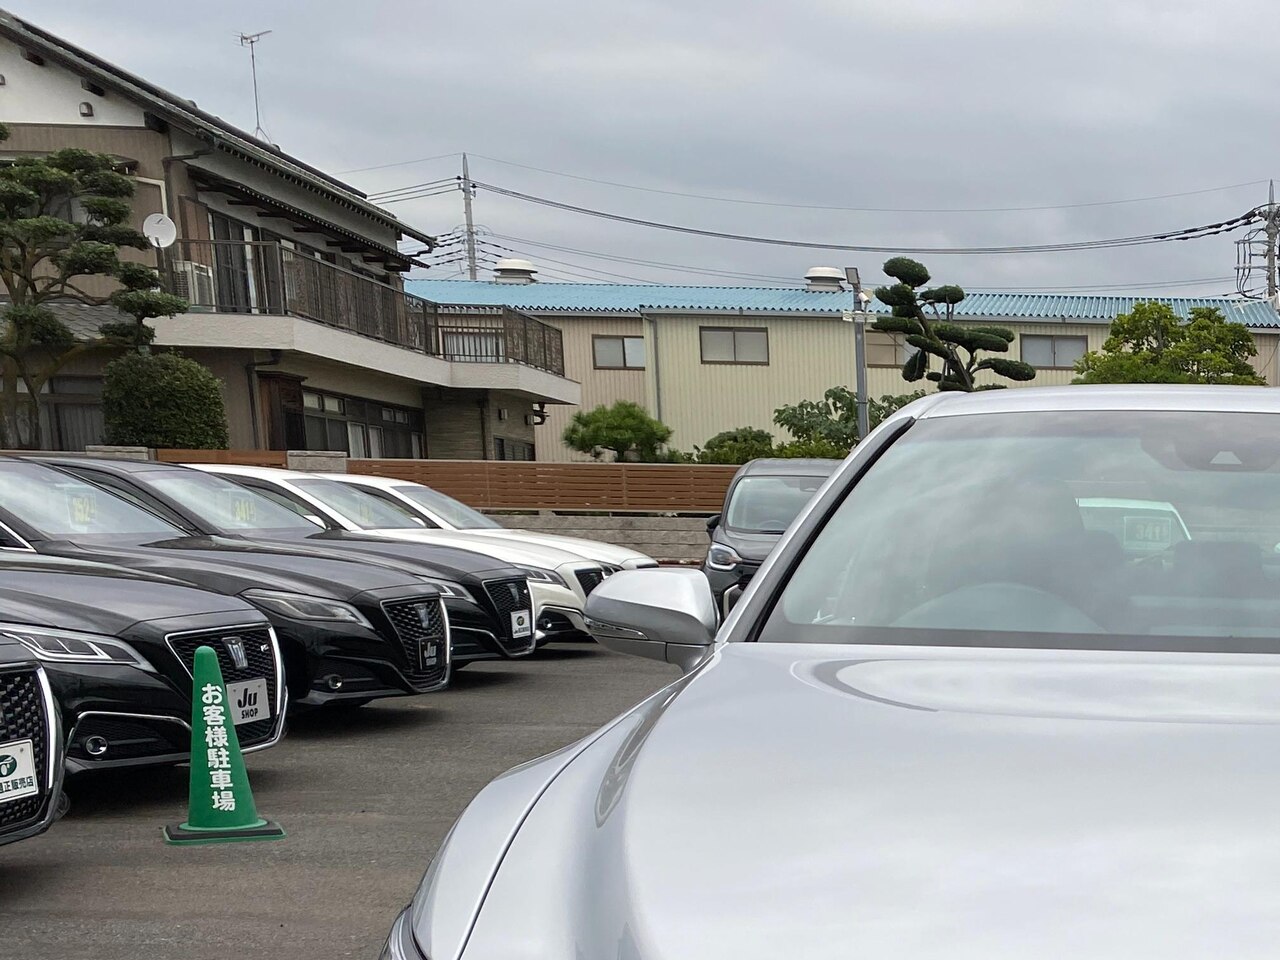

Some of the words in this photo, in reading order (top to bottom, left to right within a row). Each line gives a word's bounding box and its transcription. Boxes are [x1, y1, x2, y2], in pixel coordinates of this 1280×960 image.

[237, 688, 258, 708] Ju
[241, 707, 258, 719] SHOP
[201, 683, 236, 811] お客様駐車場
[0, 775, 34, 793] 正販売店
